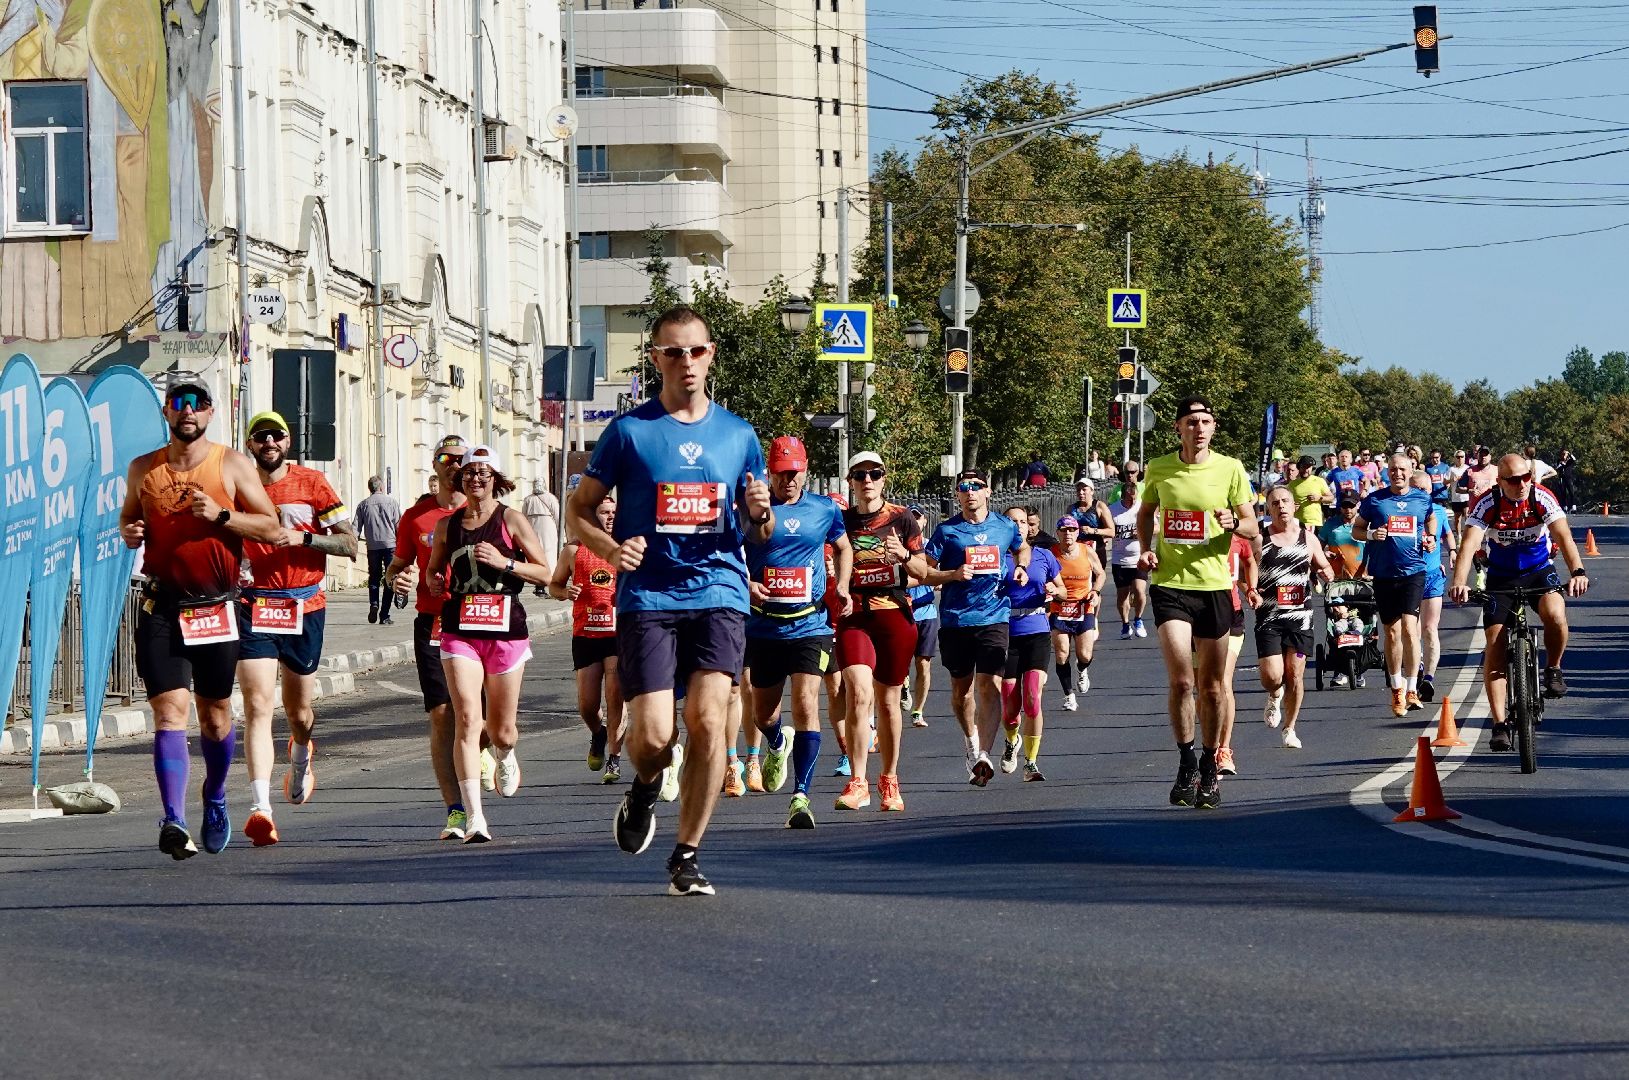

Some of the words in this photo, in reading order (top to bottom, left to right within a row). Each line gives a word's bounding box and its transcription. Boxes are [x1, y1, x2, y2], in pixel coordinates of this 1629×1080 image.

[253, 295, 281, 303] ТАБАК
[260, 306, 274, 316] 24
[0, 384, 30, 467] 11
[90, 401, 114, 477] 1
[42, 408, 68, 488] 6
[5, 465, 36, 507] КМ
[44, 485, 75, 530] КМ
[666, 497, 711, 514] 2018
[1167, 519, 1201, 531] 2082
[97, 537, 119, 562] 21.1
[970, 553, 996, 564] 2149
[767, 577, 804, 589] 2084
[860, 572, 891, 585] 2053
[1282, 592, 1300, 601] 2101
[259, 607, 292, 620] 2103
[465, 604, 500, 618] 2156
[587, 613, 611, 622] 2036
[189, 614, 222, 631] 2112
